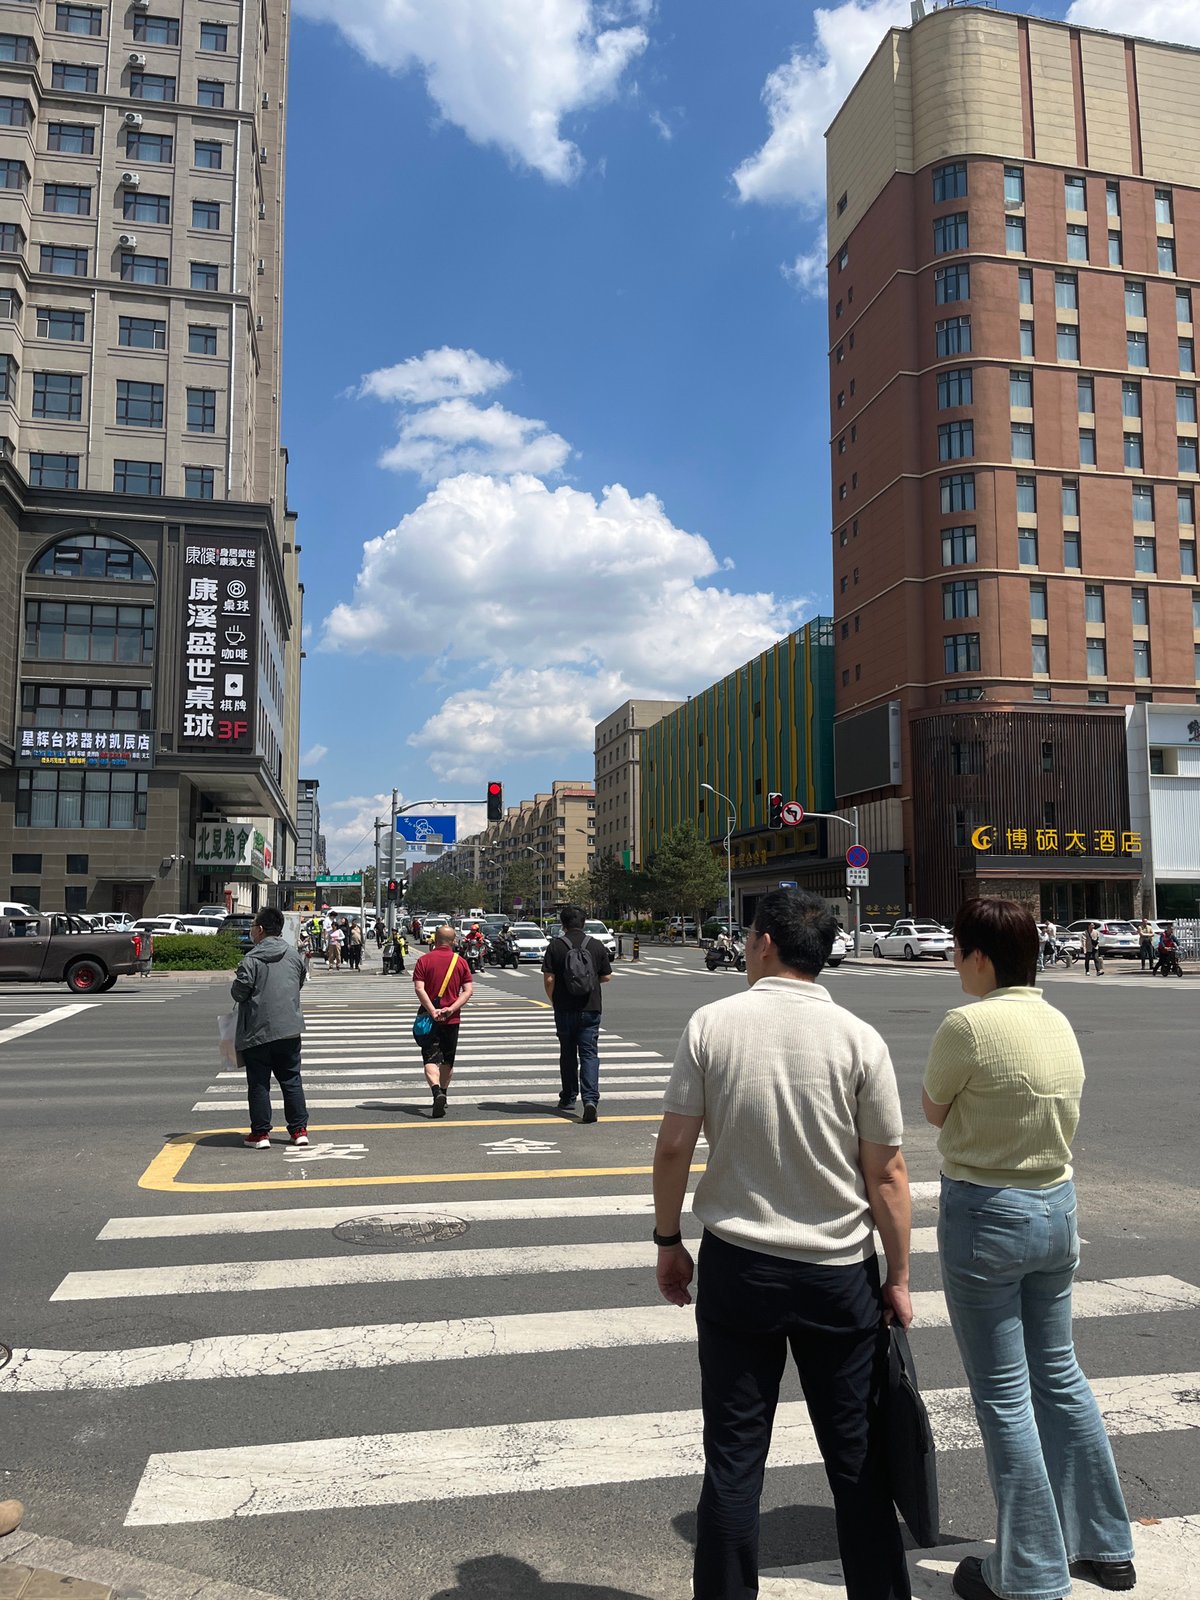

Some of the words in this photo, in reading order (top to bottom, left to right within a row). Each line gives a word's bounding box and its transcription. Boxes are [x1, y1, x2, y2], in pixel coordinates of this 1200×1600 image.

[223, 599, 250, 611] 桌球
[184, 577, 218, 737] 康溪盛世桌球
[221, 648, 248, 660] 咖啡
[220, 699, 247, 712] 棋牌
[218, 720, 248, 739] 3F
[21, 730, 150, 751] 星辉台球器材凯辰店
[1006, 828, 1142, 852] 博硕大酒店
